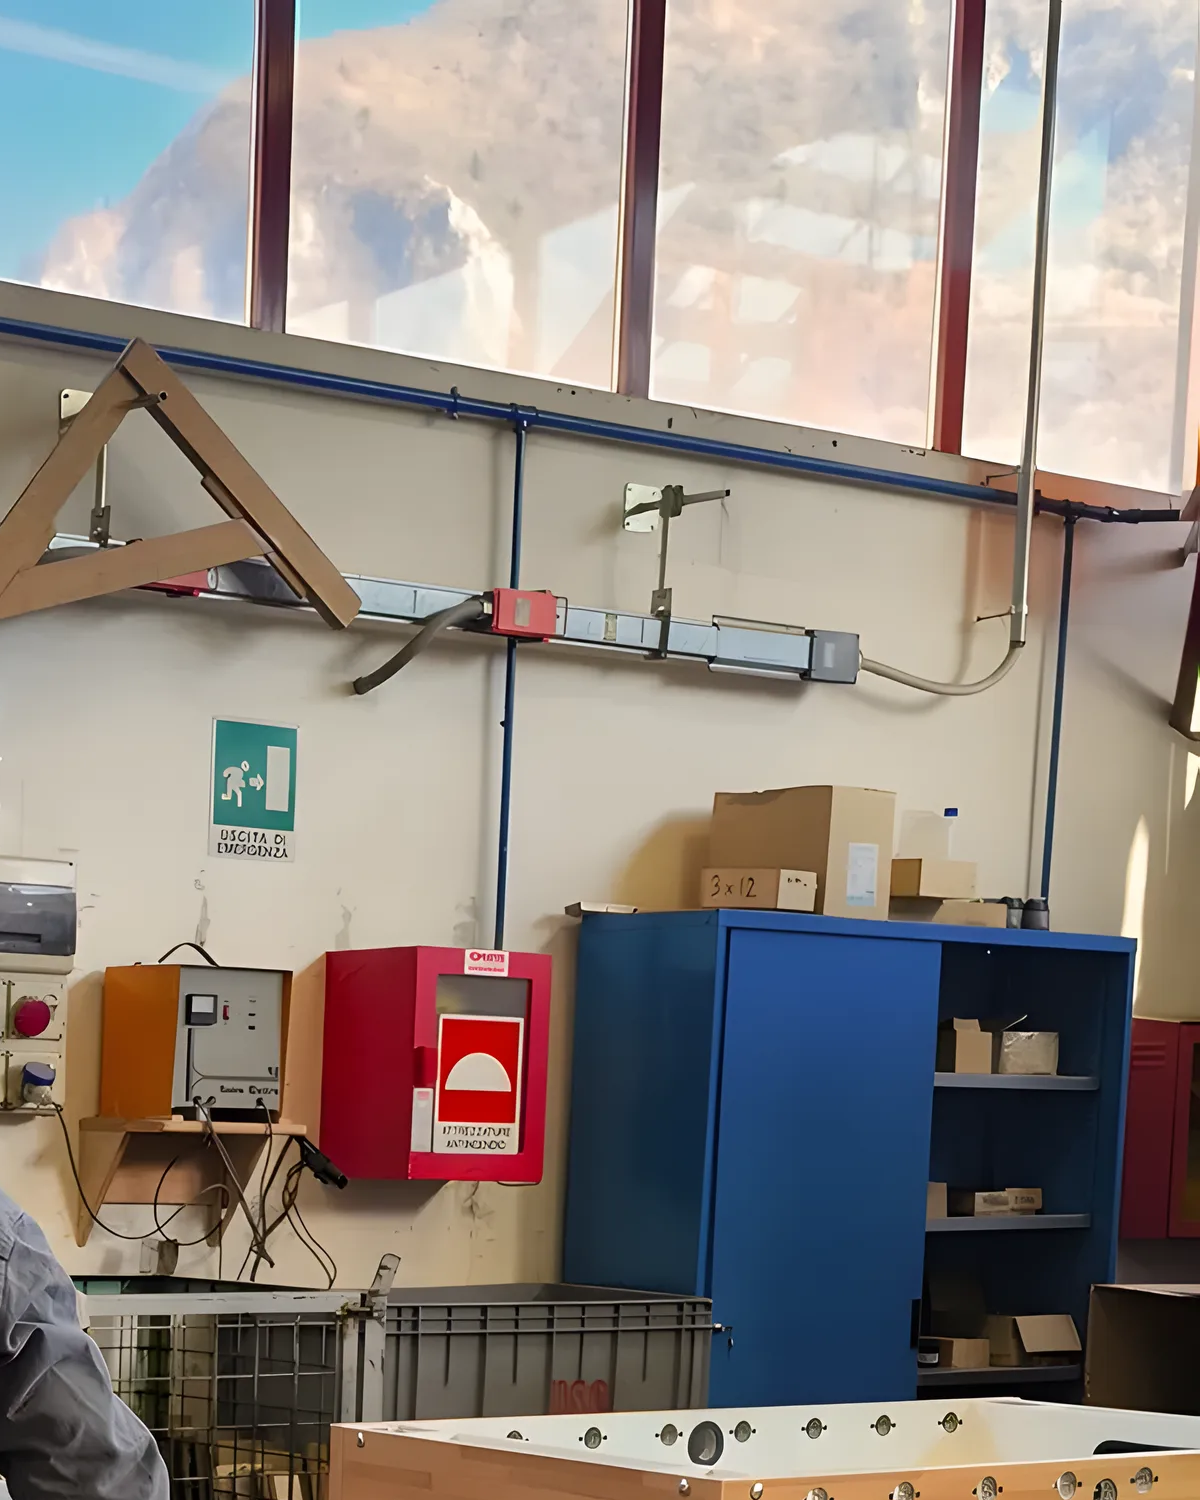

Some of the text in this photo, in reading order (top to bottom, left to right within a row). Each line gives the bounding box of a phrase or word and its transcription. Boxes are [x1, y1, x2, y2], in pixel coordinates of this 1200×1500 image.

[220, 829, 286, 845] USCITA DI
[711, 874, 721, 897] 3
[739, 876, 757, 898] 12
